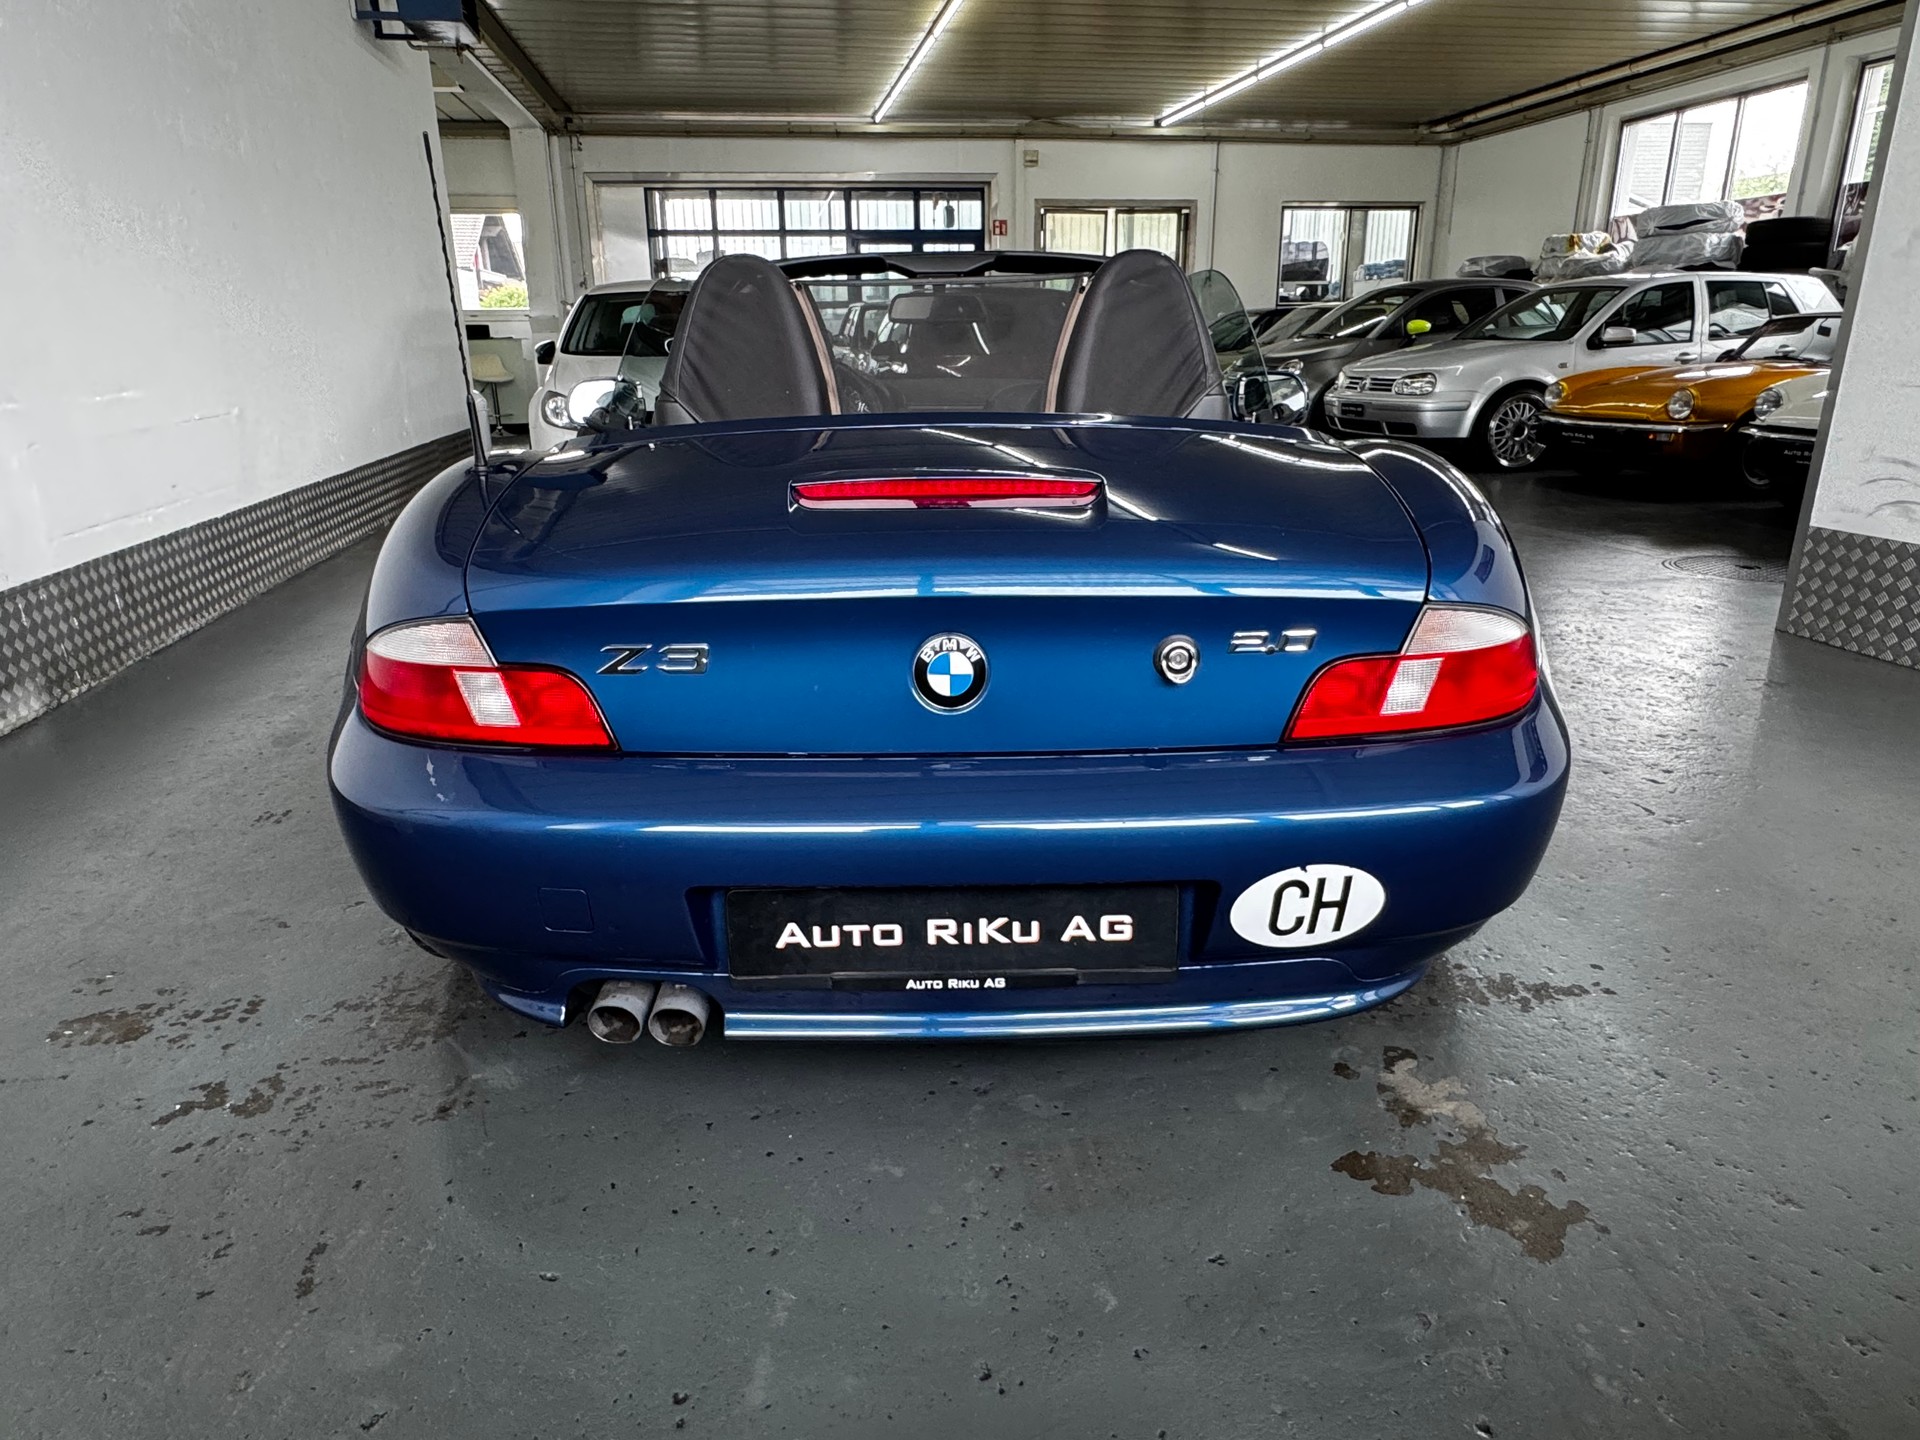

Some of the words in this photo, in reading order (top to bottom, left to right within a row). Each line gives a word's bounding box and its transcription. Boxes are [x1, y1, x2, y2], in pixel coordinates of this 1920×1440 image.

[920, 638, 981, 663] BMW
[1268, 875, 1353, 936] CH
[775, 922, 903, 949] AUTO
[1060, 914, 1133, 942] AG
[905, 979, 943, 990] AUTO
[983, 977, 1006, 989] AG
